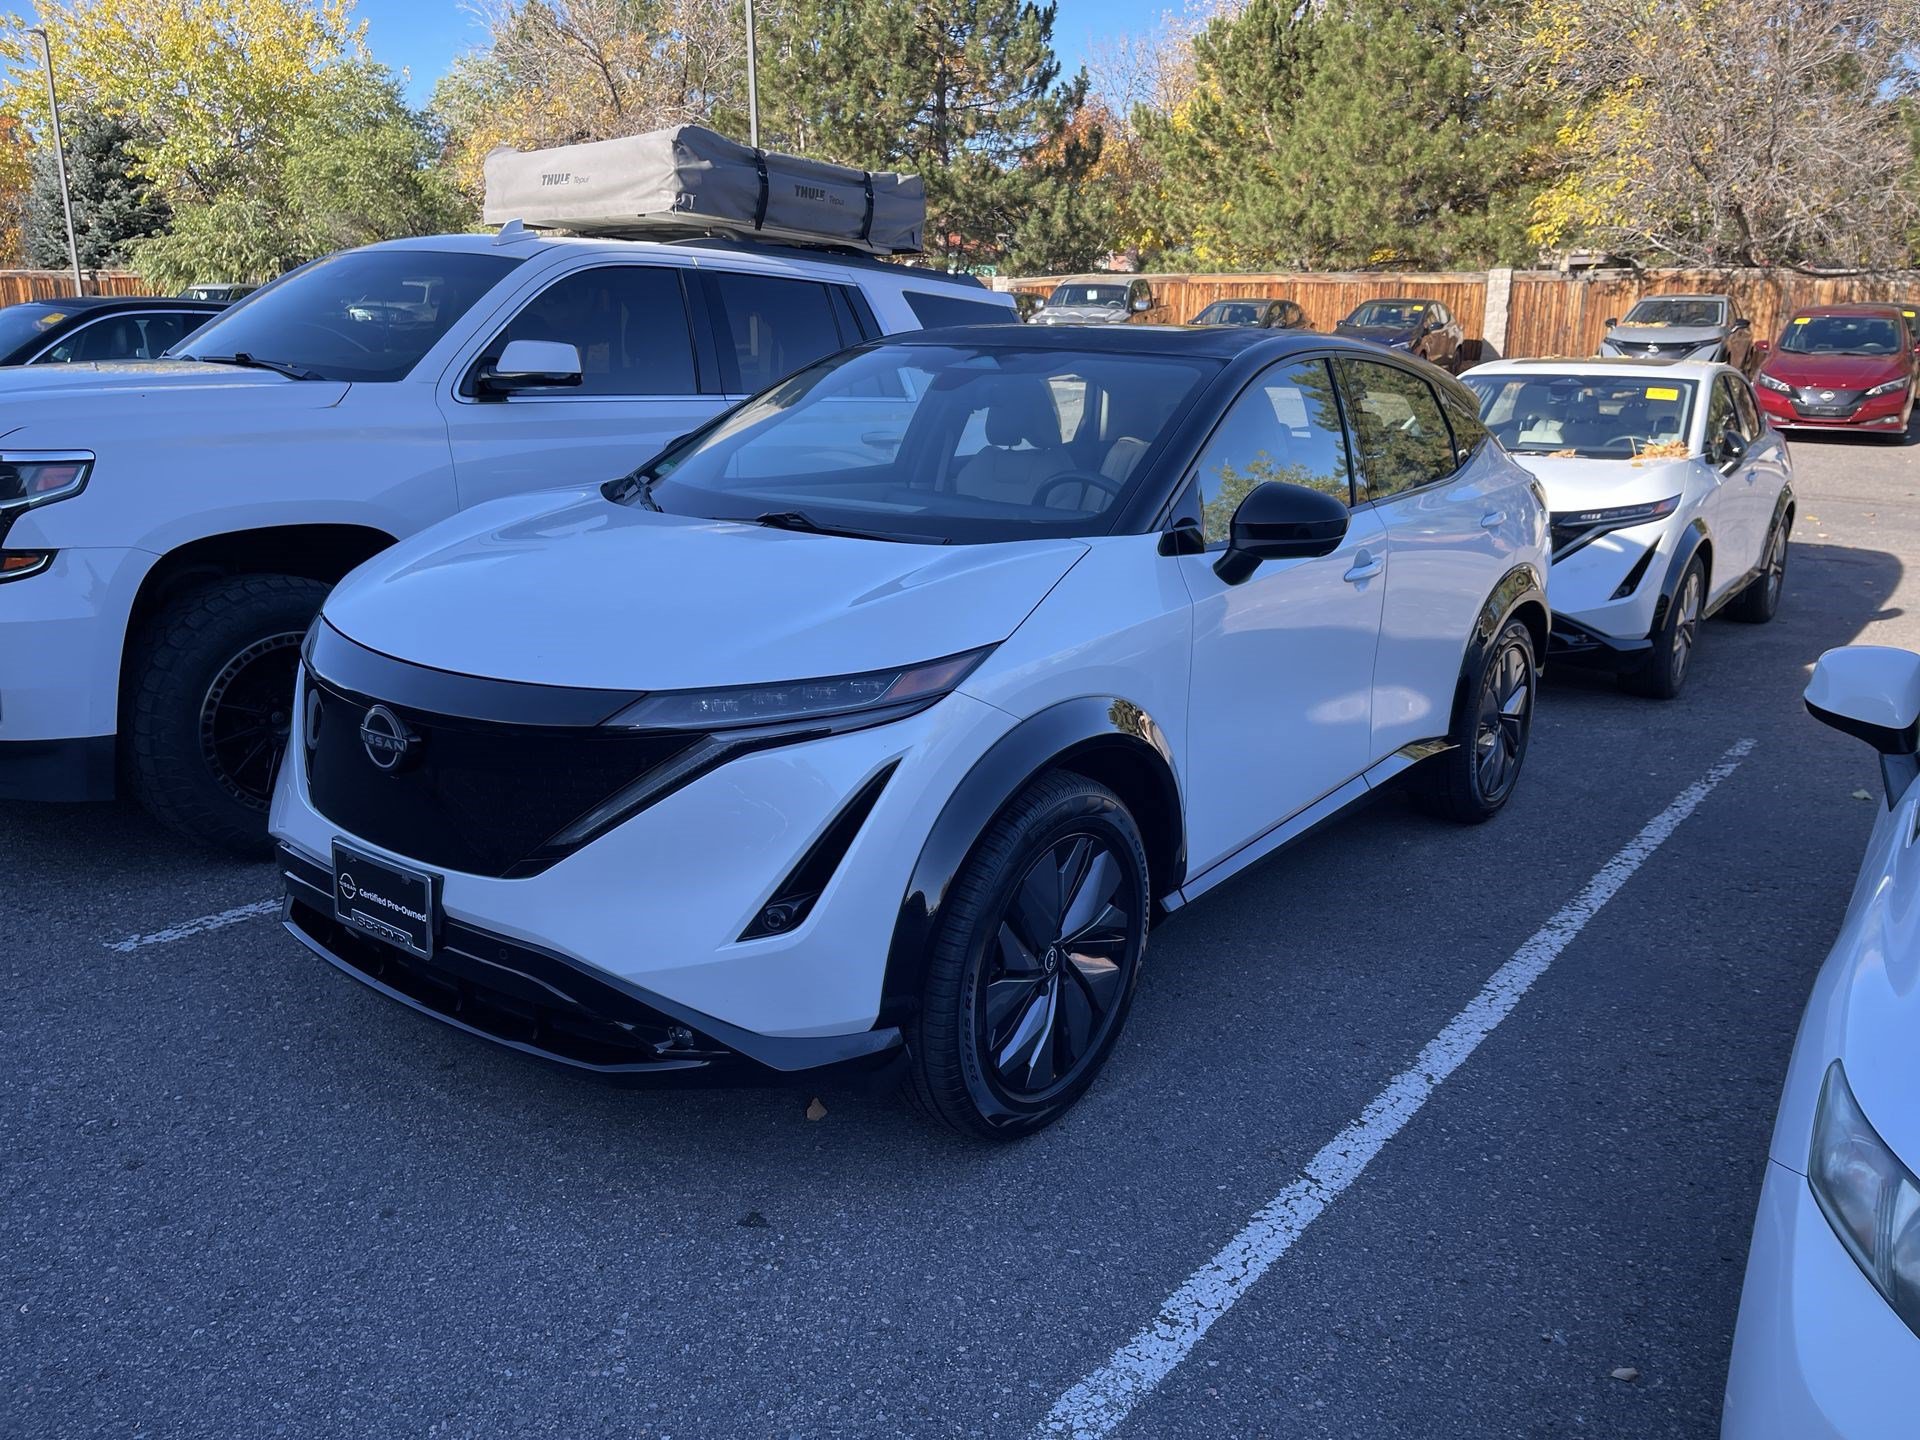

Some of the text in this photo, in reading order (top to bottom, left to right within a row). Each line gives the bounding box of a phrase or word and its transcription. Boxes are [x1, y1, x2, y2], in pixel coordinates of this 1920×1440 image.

[541, 173, 571, 186] THULE
[795, 184, 825, 201] THULE
[360, 730, 405, 752] NISSAN
[359, 888, 427, 922] Certified Pre-Owned
